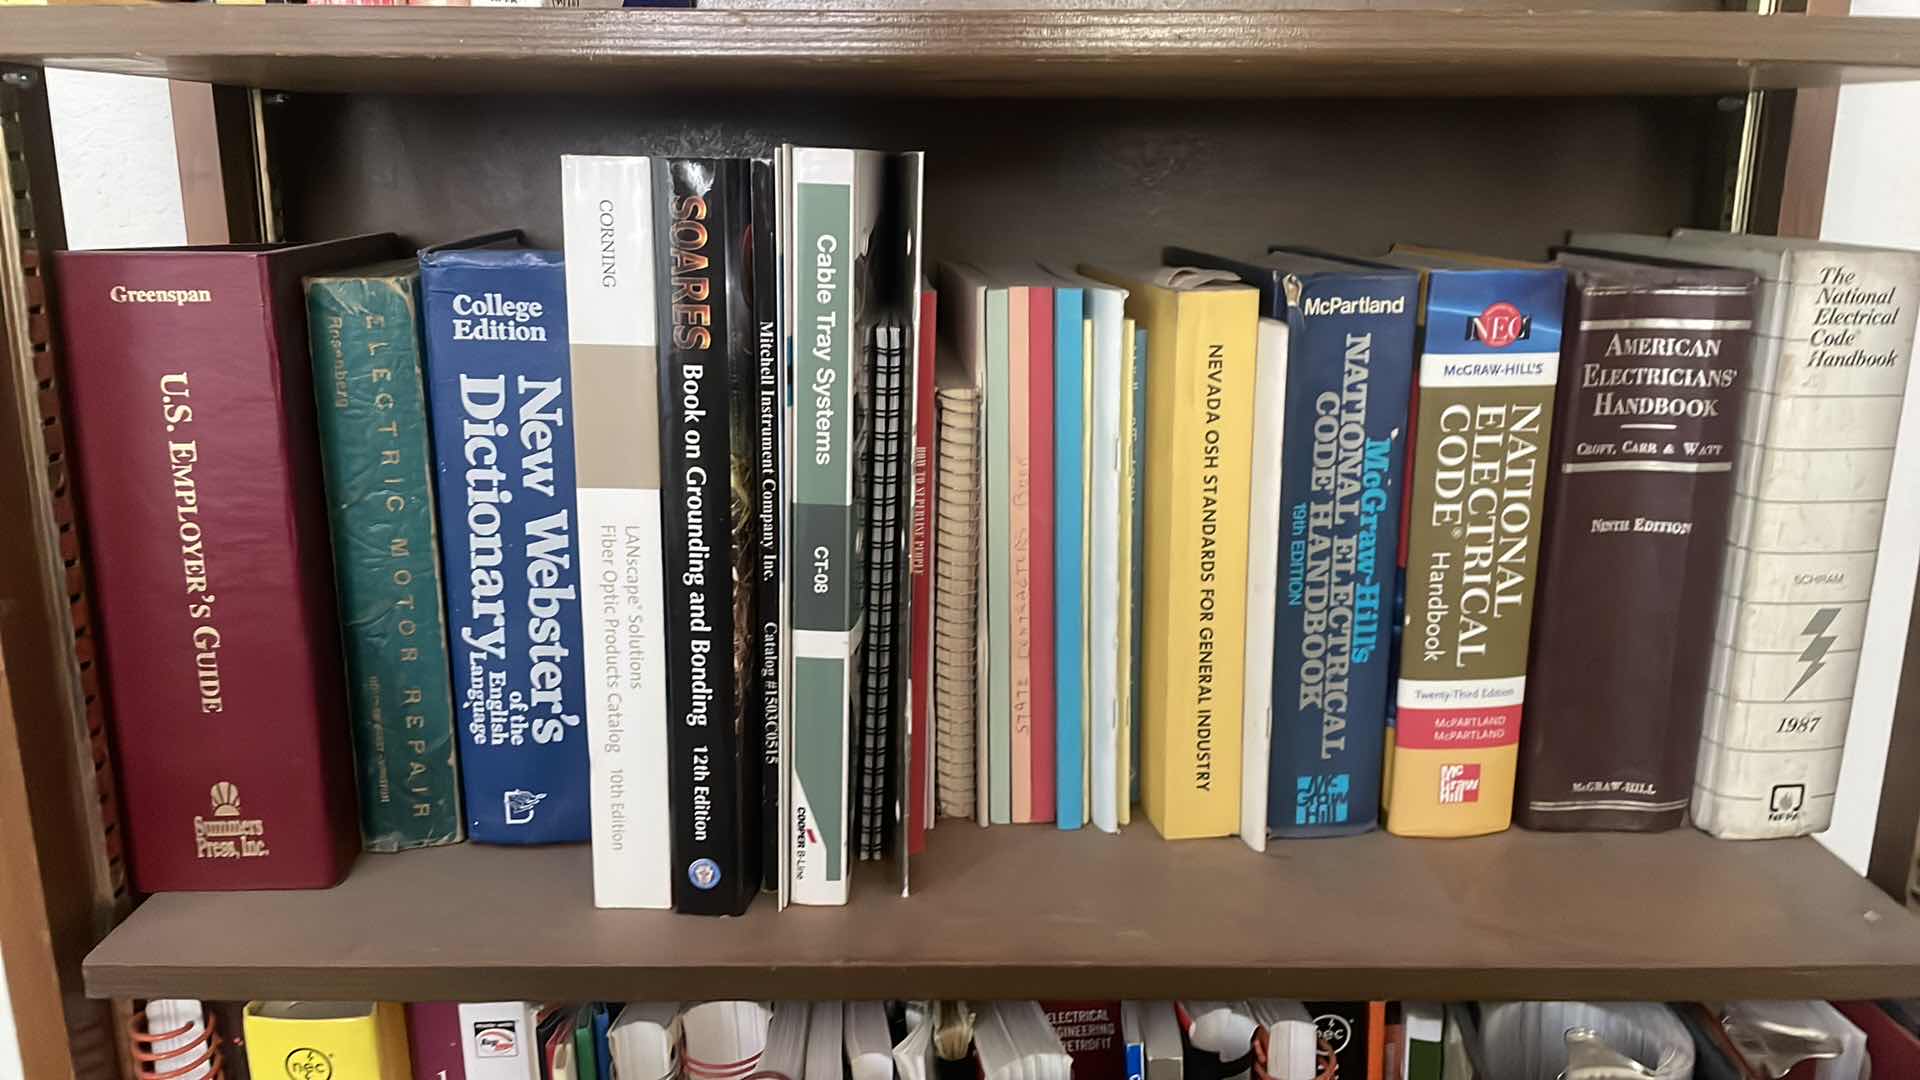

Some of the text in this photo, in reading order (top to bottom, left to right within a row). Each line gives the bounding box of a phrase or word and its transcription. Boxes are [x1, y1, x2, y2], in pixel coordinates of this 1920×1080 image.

[599, 199, 617, 289] CORNING
[110, 286, 212, 306] Greenspan
[669, 194, 713, 352] SOARES
[1814, 287, 1896, 305] National
[1820, 266, 1856, 285] The
[452, 293, 543, 322] College
[452, 318, 547, 342] Edition
[1304, 296, 1404, 316] McPartland
[1813, 307, 1900, 327] Electrical
[759, 321, 775, 387] Mitchell
[812, 233, 837, 466] Cable Tray Systems
[1605, 333, 1722, 357] AMERICAN
[1806, 350, 1898, 369] Handbook
[761, 390, 777, 475] Instrument
[1592, 392, 1720, 418] HANDBOOK
[1622, 440, 1657, 455] CARR
[1662, 443, 1675, 455] &
[1683, 442, 1722, 456] WATT
[458, 373, 513, 660] Dictionary
[759, 477, 777, 549] Company
[1456, 403, 1507, 668] ELECTRICAL
[1493, 403, 1543, 618] NATIONAL
[1591, 518, 1693, 535] NINTH EDITION
[160, 371, 223, 714] U.S. EMPLOYER'S GUIDE
[365, 314, 431, 817] ELECTRIC MOTOR REPAIR
[517, 374, 581, 745] New Webster's
[762, 552, 777, 582] Inc.
[814, 545, 829, 594] CT-08
[1195, 343, 1223, 793] NEVADA OSH STANDARDS FOR GENERAL INDUSTRY
[1288, 502, 1308, 606] 19th EDITION
[1299, 391, 1341, 711] CODE HANDBOOK
[1320, 332, 1372, 759] NATIONAL ELECTRICAL
[1350, 437, 1392, 664] McGraw-Hill's
[682, 363, 714, 842] Book on Grounding and Bonding 12th Edition
[1424, 551, 1452, 662] Handbook
[626, 614, 646, 690] Solutions
[761, 621, 778, 677] Catalog
[462, 650, 488, 745] Language
[486, 670, 509, 746] English
[599, 524, 627, 851] Fiber Optic Products Catalog 10th Edition
[1481, 686, 1515, 698] Edition
[509, 690, 529, 746] of the
[1433, 728, 1505, 741] McPARTLAND
[1434, 714, 1507, 729] McPARTLAND
[1775, 716, 1822, 734] 1987
[1439, 788, 1463, 804] Hill
[1440, 765, 1463, 778] Mc
[1441, 779, 1479, 791] Graw
[194, 816, 264, 837] Summers
[197, 836, 269, 859] Press, Inc.
[292, 1062, 325, 1073] nec
